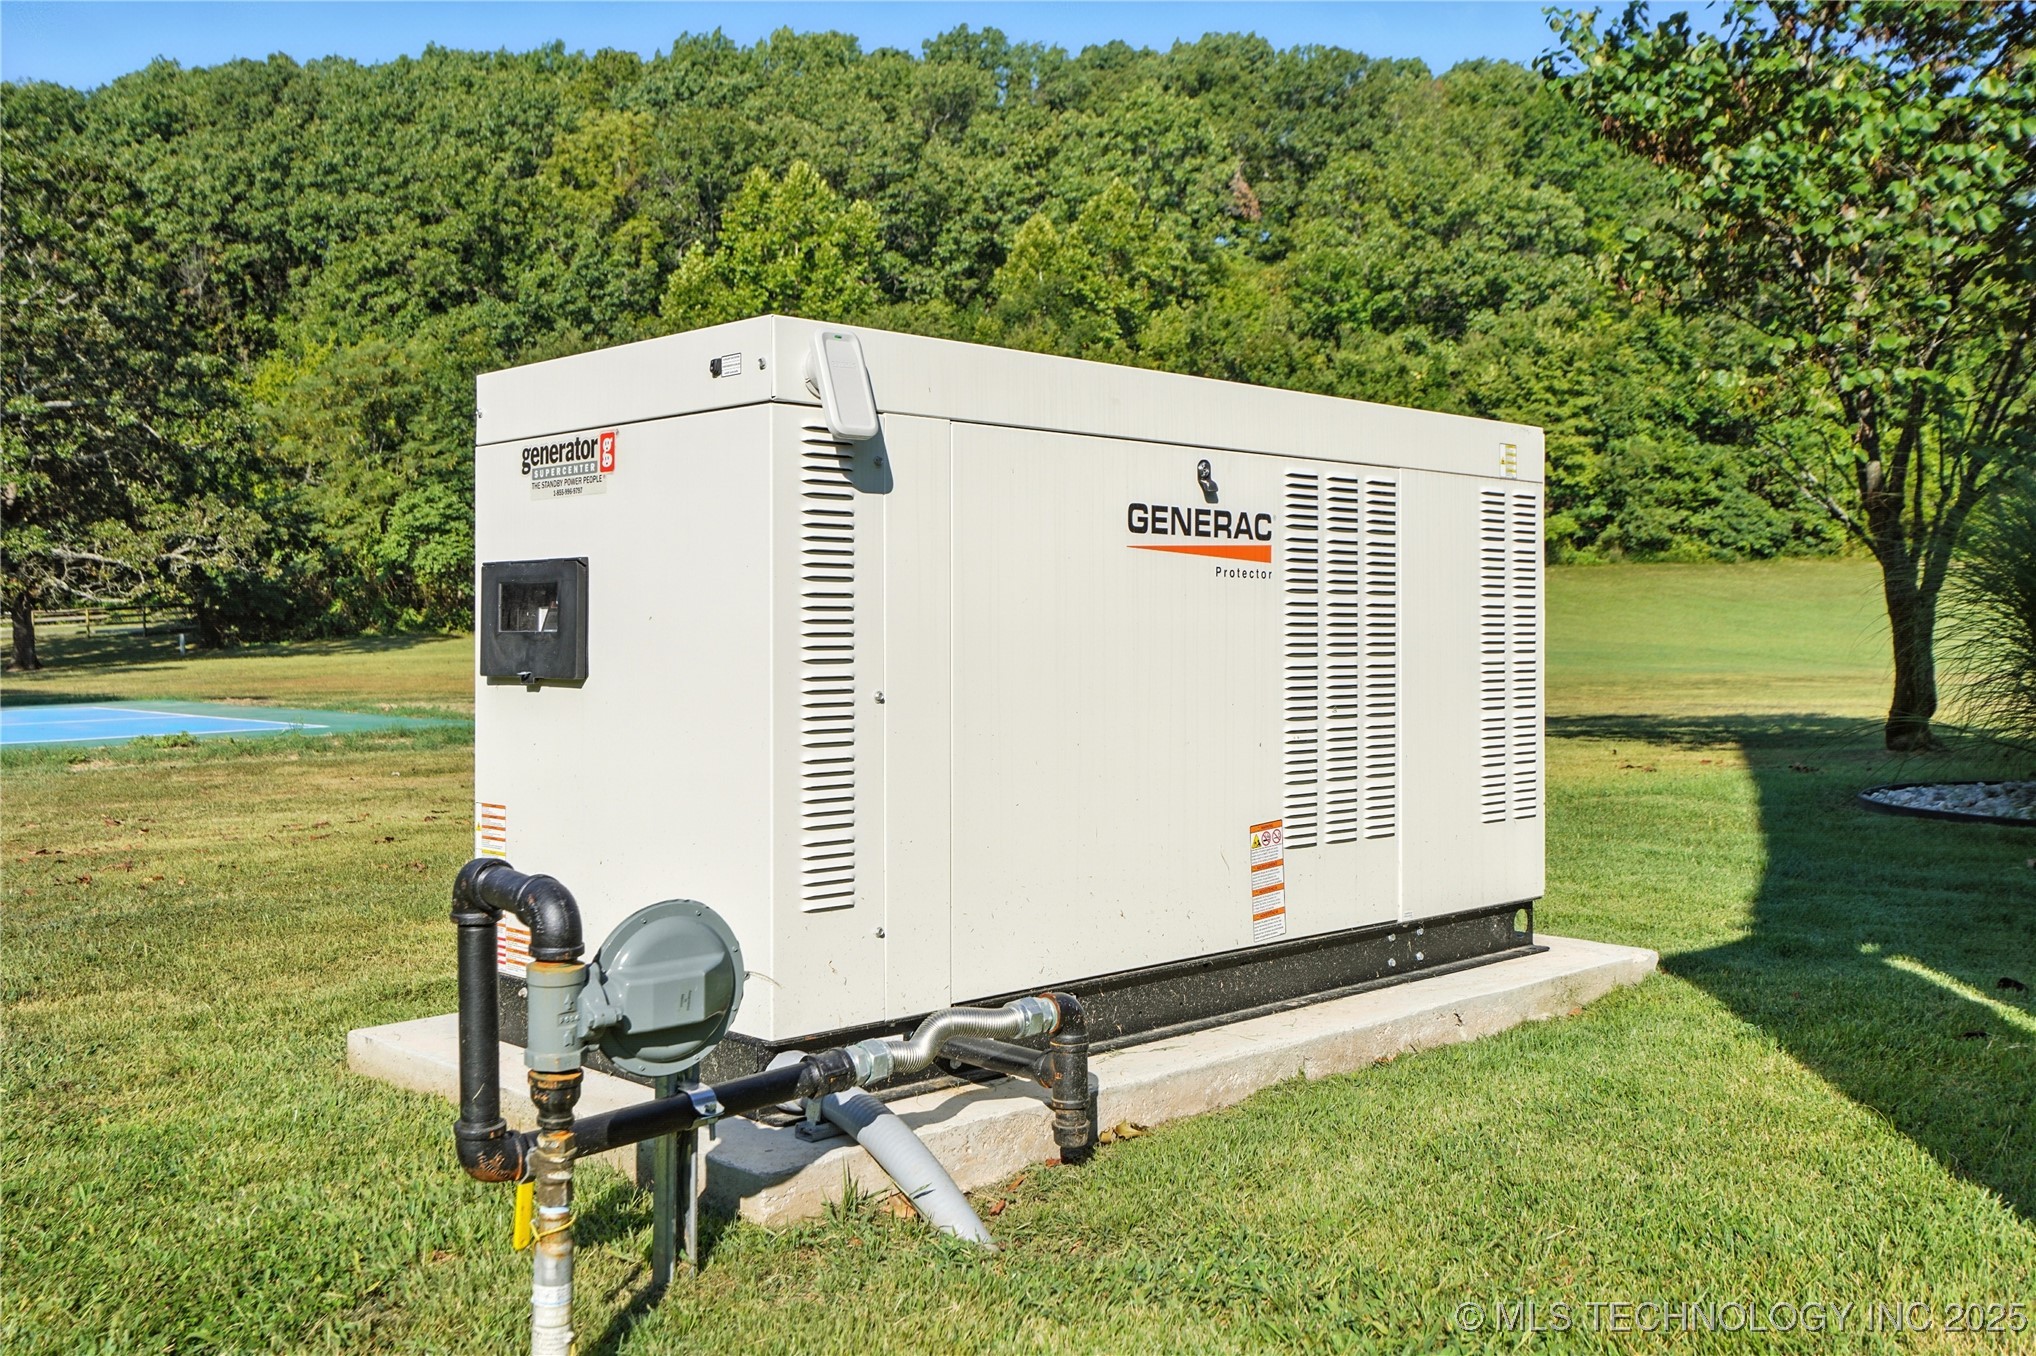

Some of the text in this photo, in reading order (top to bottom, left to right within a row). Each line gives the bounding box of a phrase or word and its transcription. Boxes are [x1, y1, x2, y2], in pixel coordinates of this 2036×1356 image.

[522, 437, 598, 475] generator
[533, 462, 596, 479] SUPERCENTER
[532, 474, 602, 490] THE STANDBY POWER PEOPLE
[1128, 503, 1272, 541] GENERAC
[1216, 566, 1273, 579] Protector
